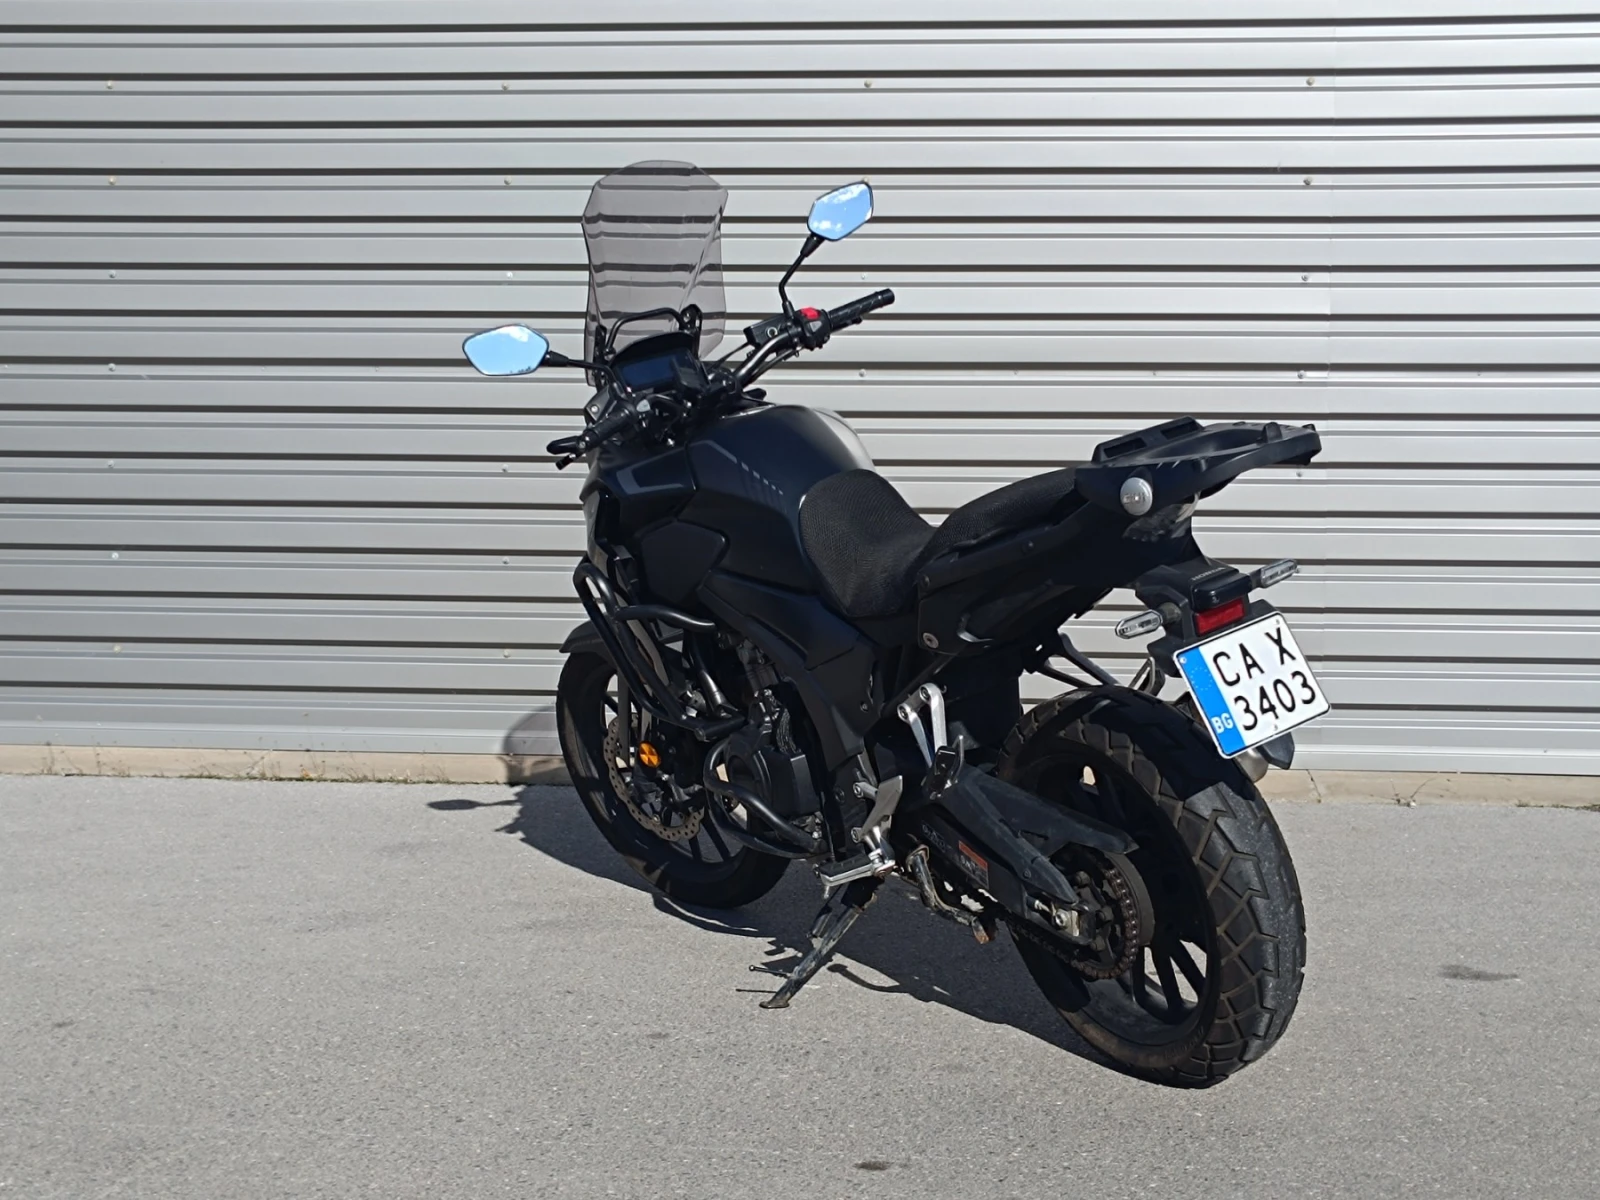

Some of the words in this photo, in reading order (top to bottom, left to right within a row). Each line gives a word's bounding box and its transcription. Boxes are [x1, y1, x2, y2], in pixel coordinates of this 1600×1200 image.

[1213, 643, 1264, 687] CA
[1264, 627, 1296, 665] X
[1211, 712, 1234, 734] BG
[1234, 670, 1316, 731] 3403
